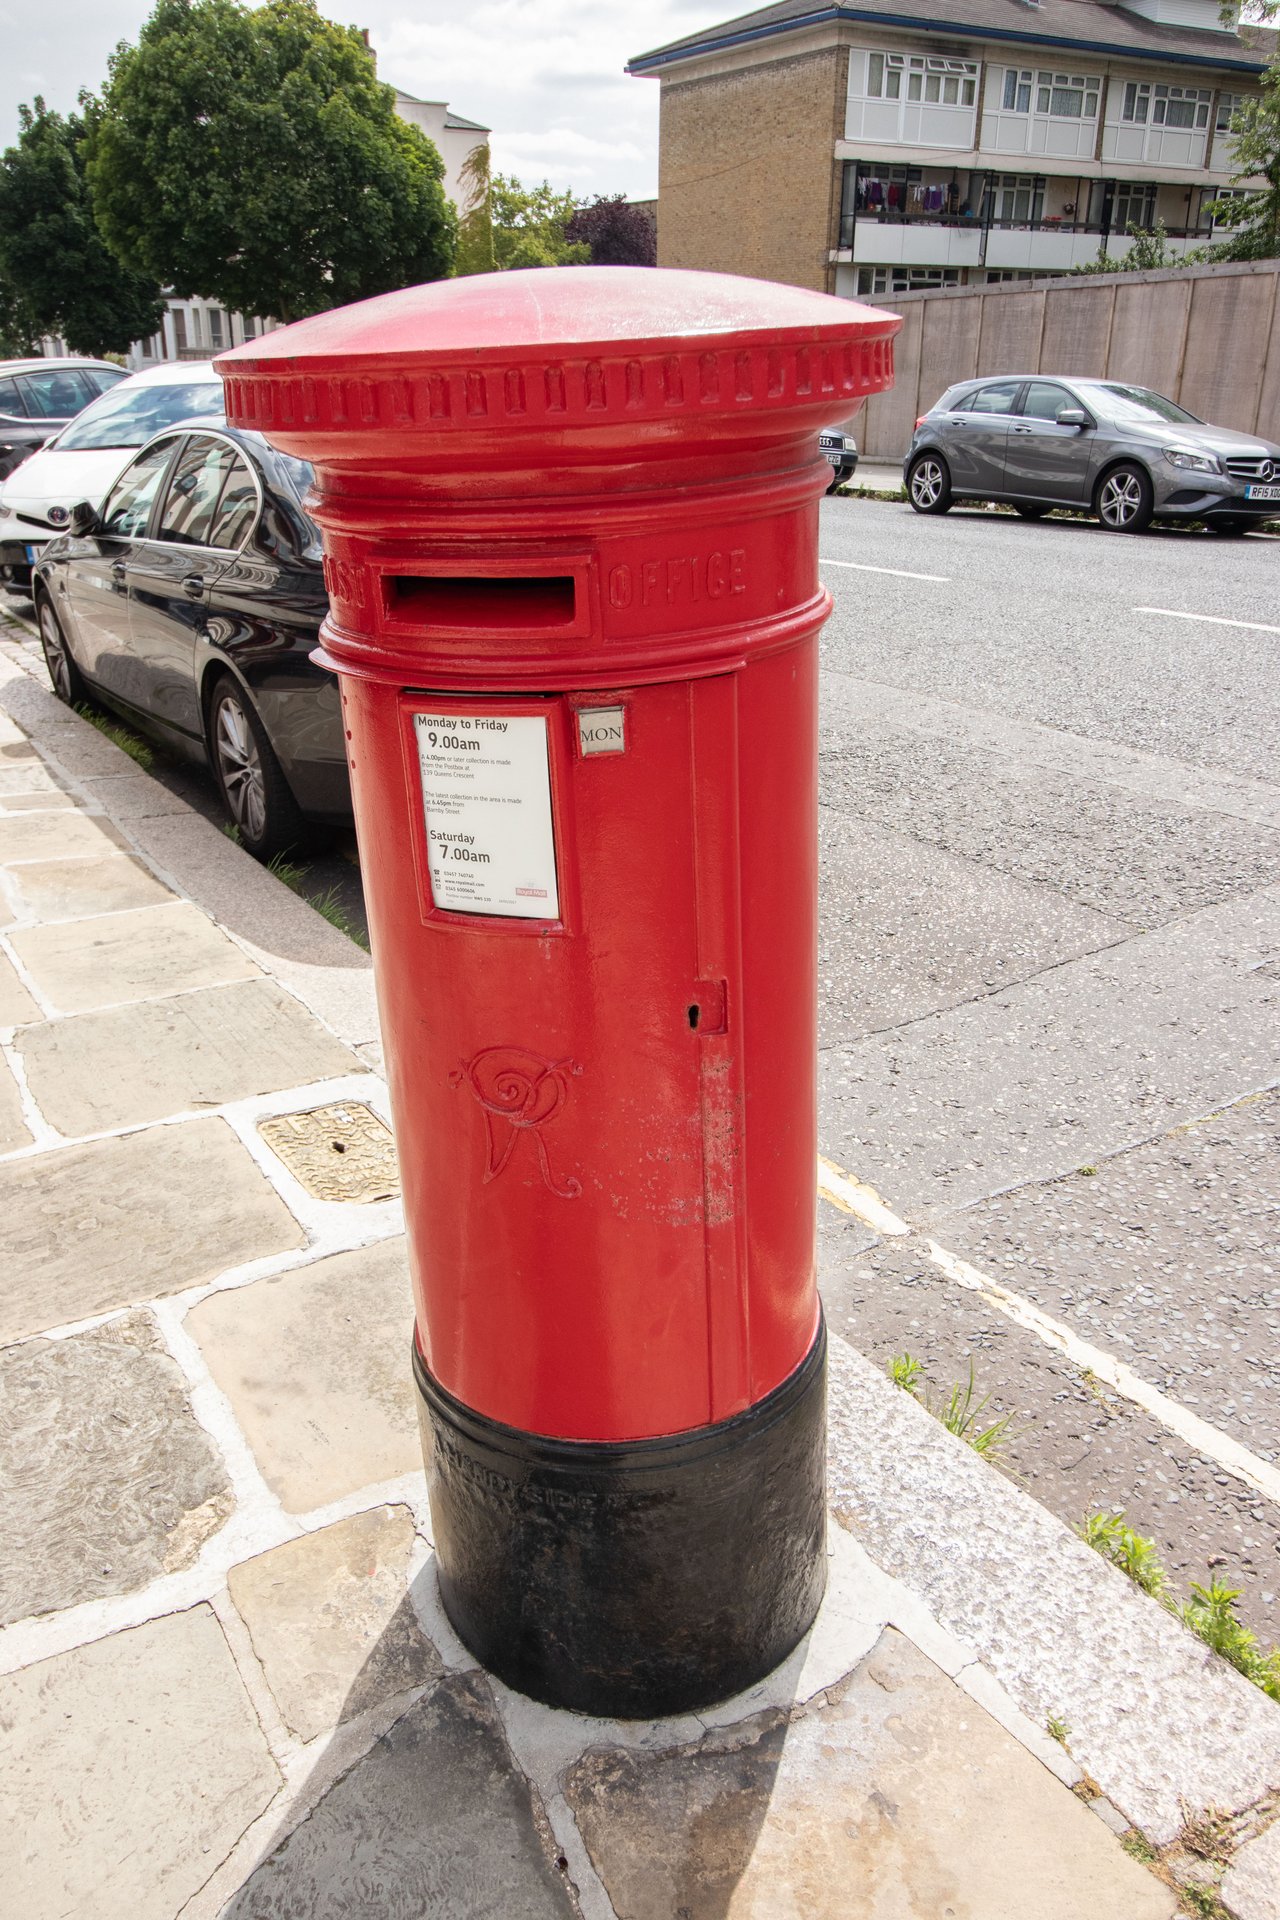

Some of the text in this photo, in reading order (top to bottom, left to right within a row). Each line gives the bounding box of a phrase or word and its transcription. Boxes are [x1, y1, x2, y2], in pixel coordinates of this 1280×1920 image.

[1252, 487, 1269, 497] RF15
[609, 550, 746, 609] OFFICE
[418, 716, 508, 732] Monday to Friday
[428, 732, 480, 750] 9.00am
[581, 727, 621, 742] MON
[430, 830, 475, 844] Saturday
[439, 845, 490, 863] 7.00am
